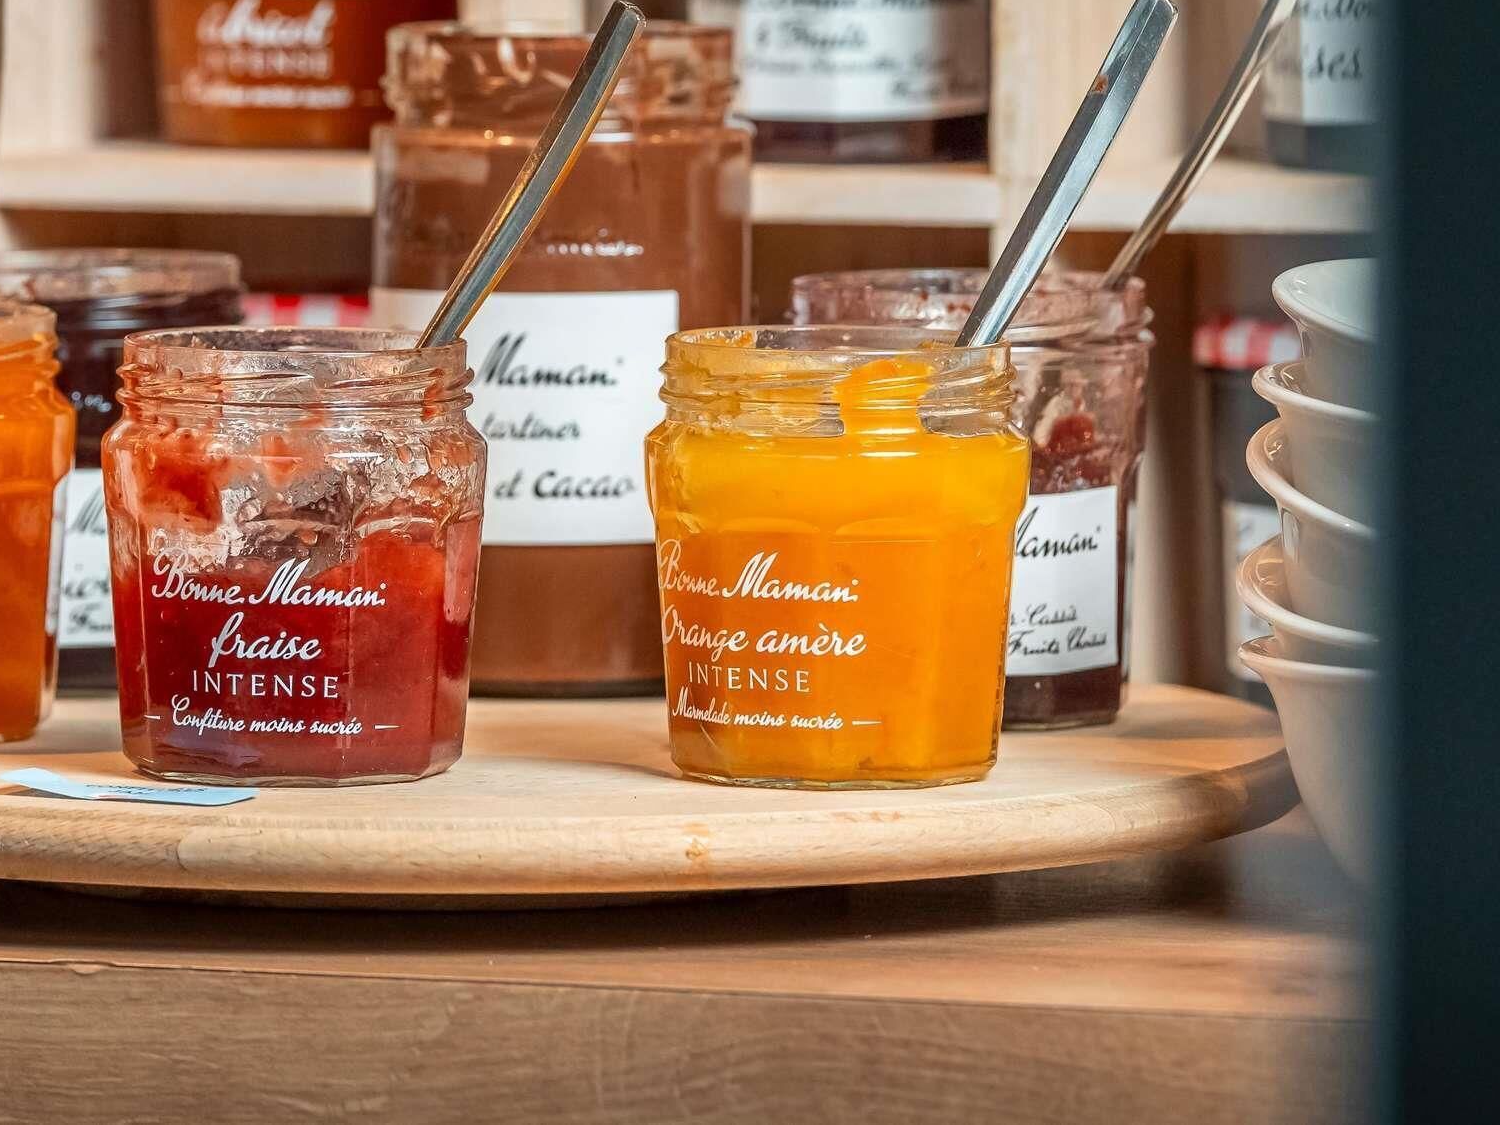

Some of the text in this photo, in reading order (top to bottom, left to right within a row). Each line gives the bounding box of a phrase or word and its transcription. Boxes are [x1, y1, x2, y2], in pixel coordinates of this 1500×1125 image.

[477, 332, 619, 387] Maman
[533, 469, 636, 500] Cacao
[151, 547, 245, 605] Bonne
[248, 557, 386, 608] Maman
[658, 539, 859, 603] Bonne Maman
[208, 611, 322, 668] fraise
[662, 603, 867, 662] Orange amère
[192, 670, 339, 699] INTENSE
[688, 661, 811, 693] INTENSE
[171, 694, 363, 735] Confiture moins sucrée
[672, 686, 844, 730] Marmelade moins sucrée
